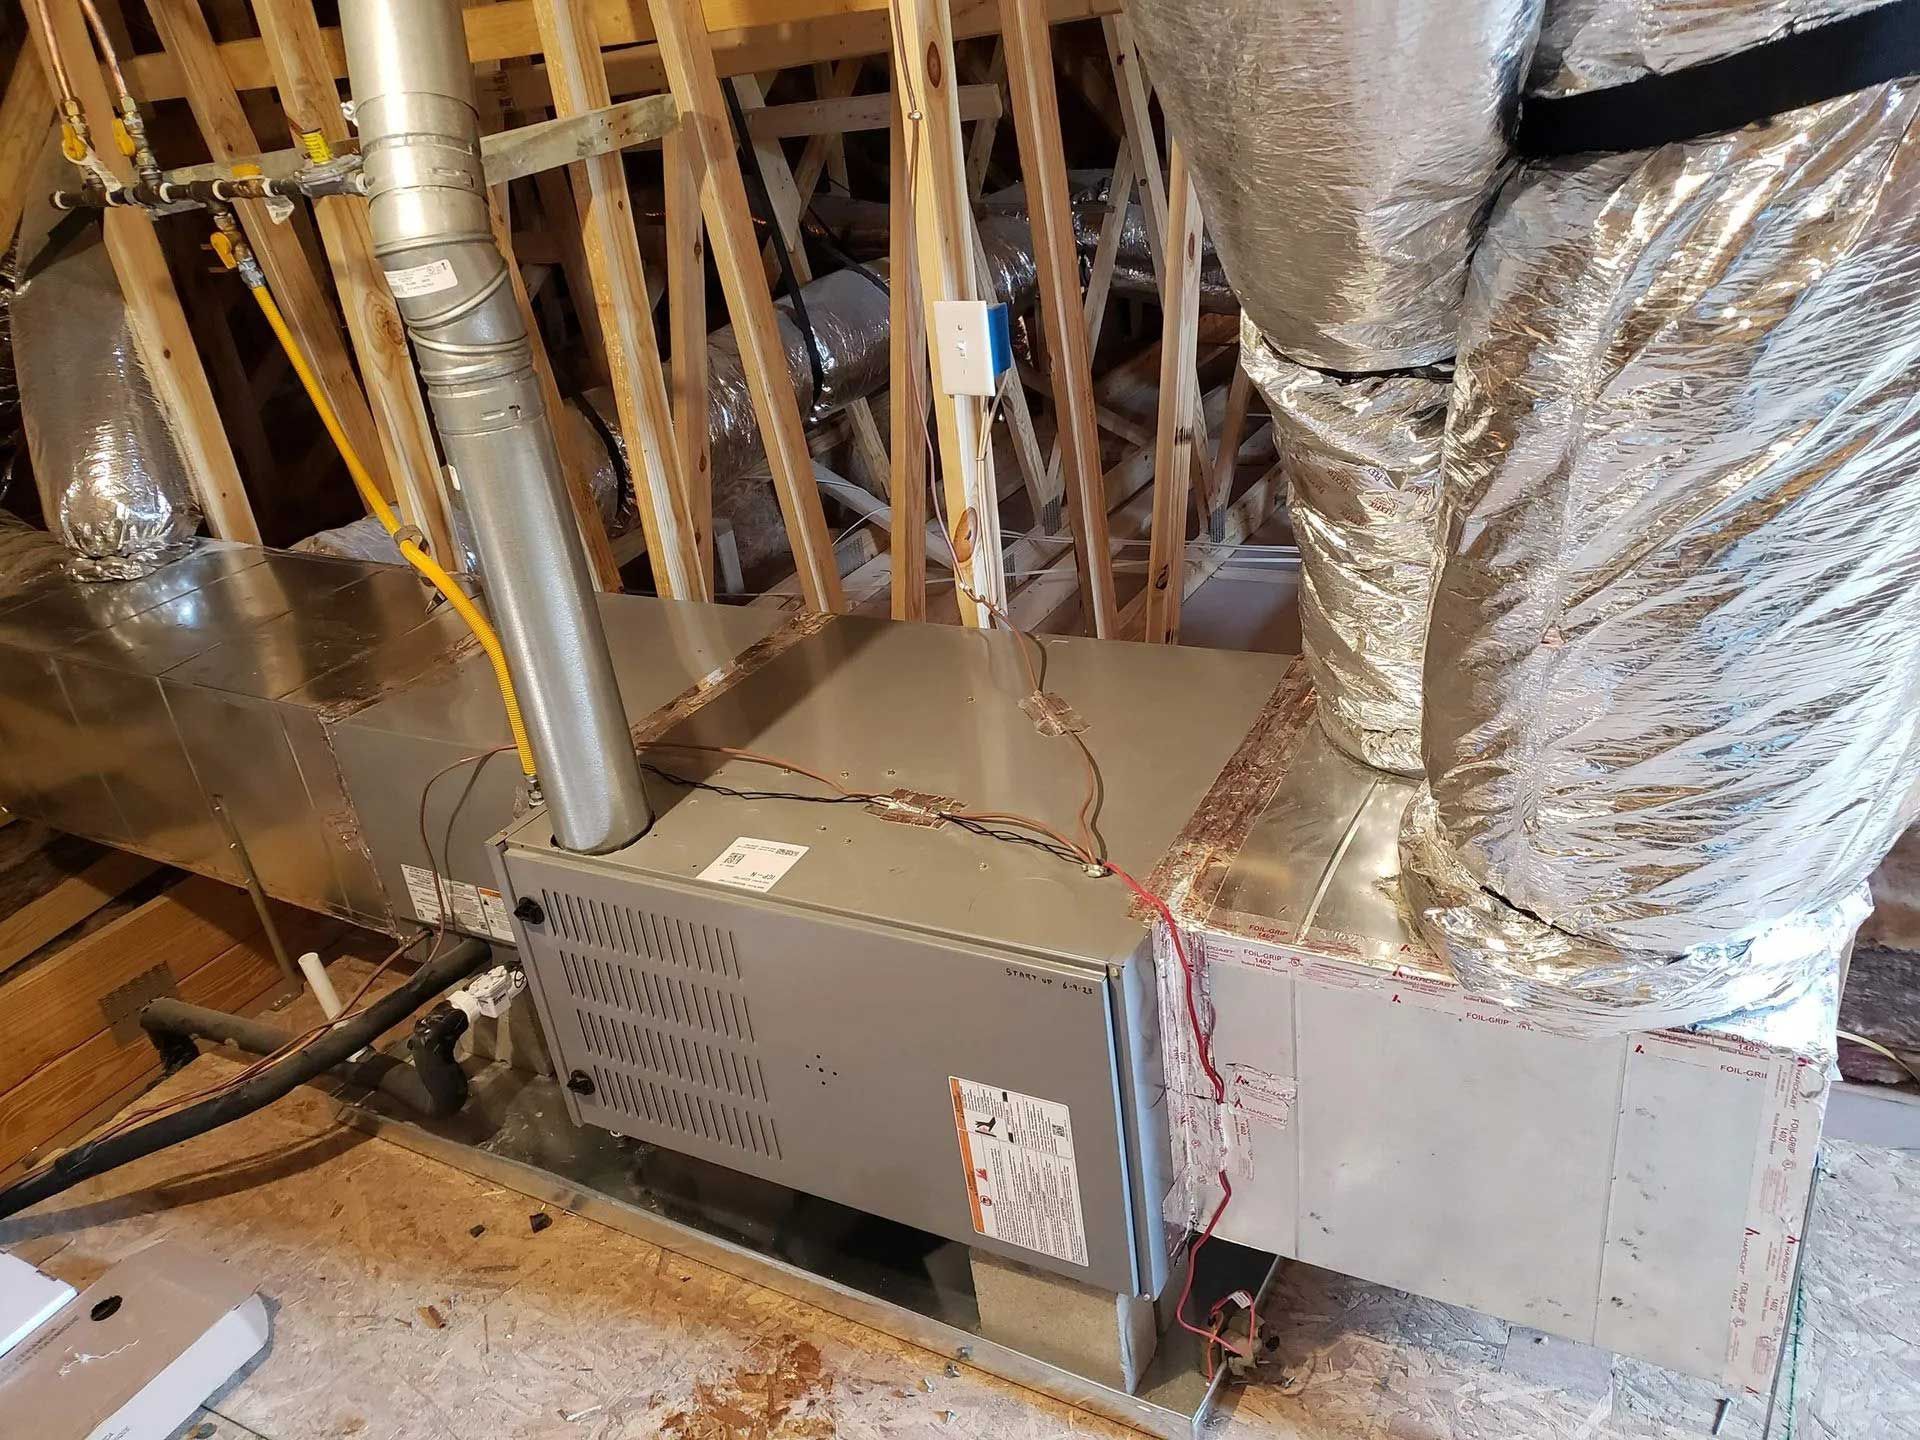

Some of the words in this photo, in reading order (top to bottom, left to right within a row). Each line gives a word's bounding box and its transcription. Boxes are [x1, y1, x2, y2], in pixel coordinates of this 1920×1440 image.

[1248, 924, 1287, 936] FOIL-GRIP
[1243, 949, 1282, 960] FOIL-GRIP
[1255, 957, 1271, 966] 1402
[1006, 967, 1036, 981] START
[1466, 1012, 1509, 1025] FOIL-GRIP
[1738, 1044, 1760, 1053] 1402
[1788, 1118, 1800, 1154] FOIL-GRIP
